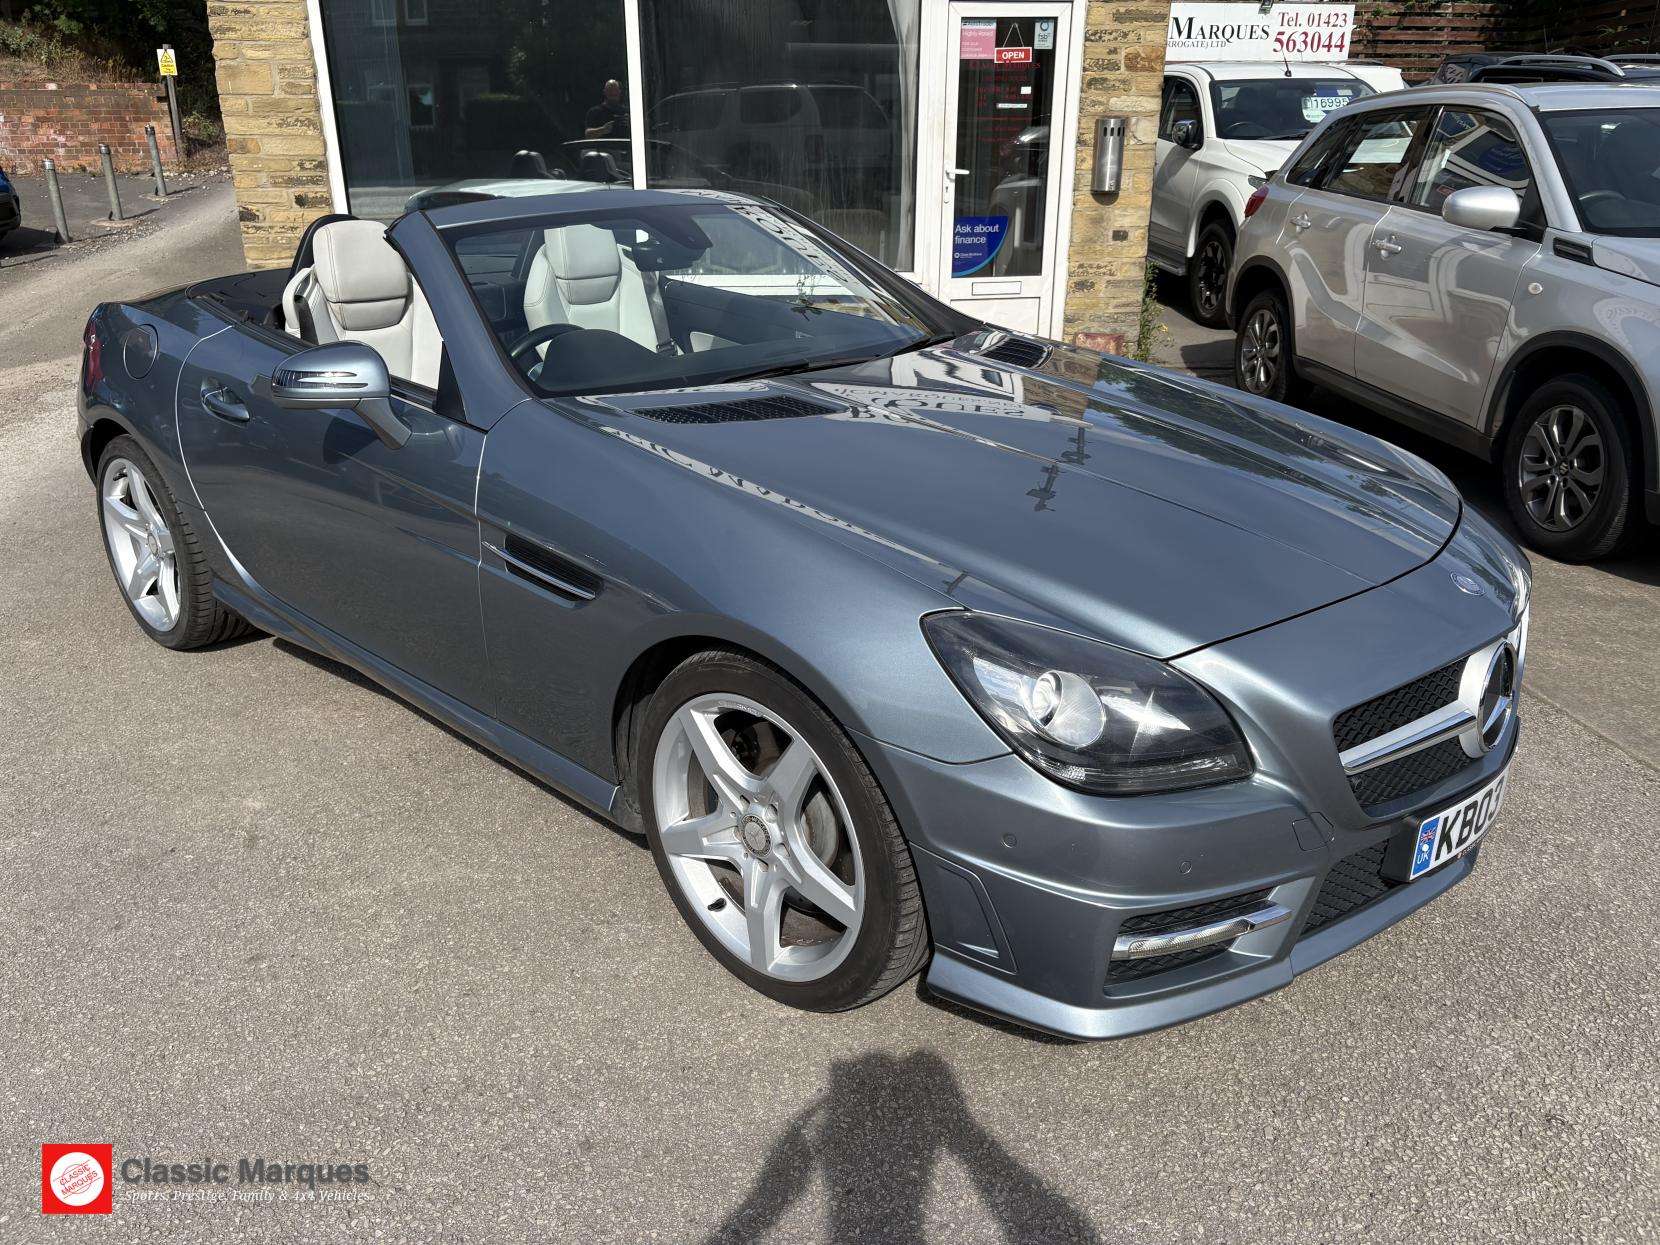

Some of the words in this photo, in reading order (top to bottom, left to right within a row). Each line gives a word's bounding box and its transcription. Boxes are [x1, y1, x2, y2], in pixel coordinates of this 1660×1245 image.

[1278, 12, 1302, 27] Tel.
[1307, 12, 1348, 28] 01423
[1169, 16, 1270, 43] MARQUES
[1210, 40, 1227, 48] LTD
[1273, 31, 1346, 53] 563044
[1002, 51, 1025, 60] OPEN
[954, 224, 971, 233] Ask
[973, 224, 1000, 233] about
[954, 235, 986, 244] finance
[1417, 850, 1429, 865] UK
